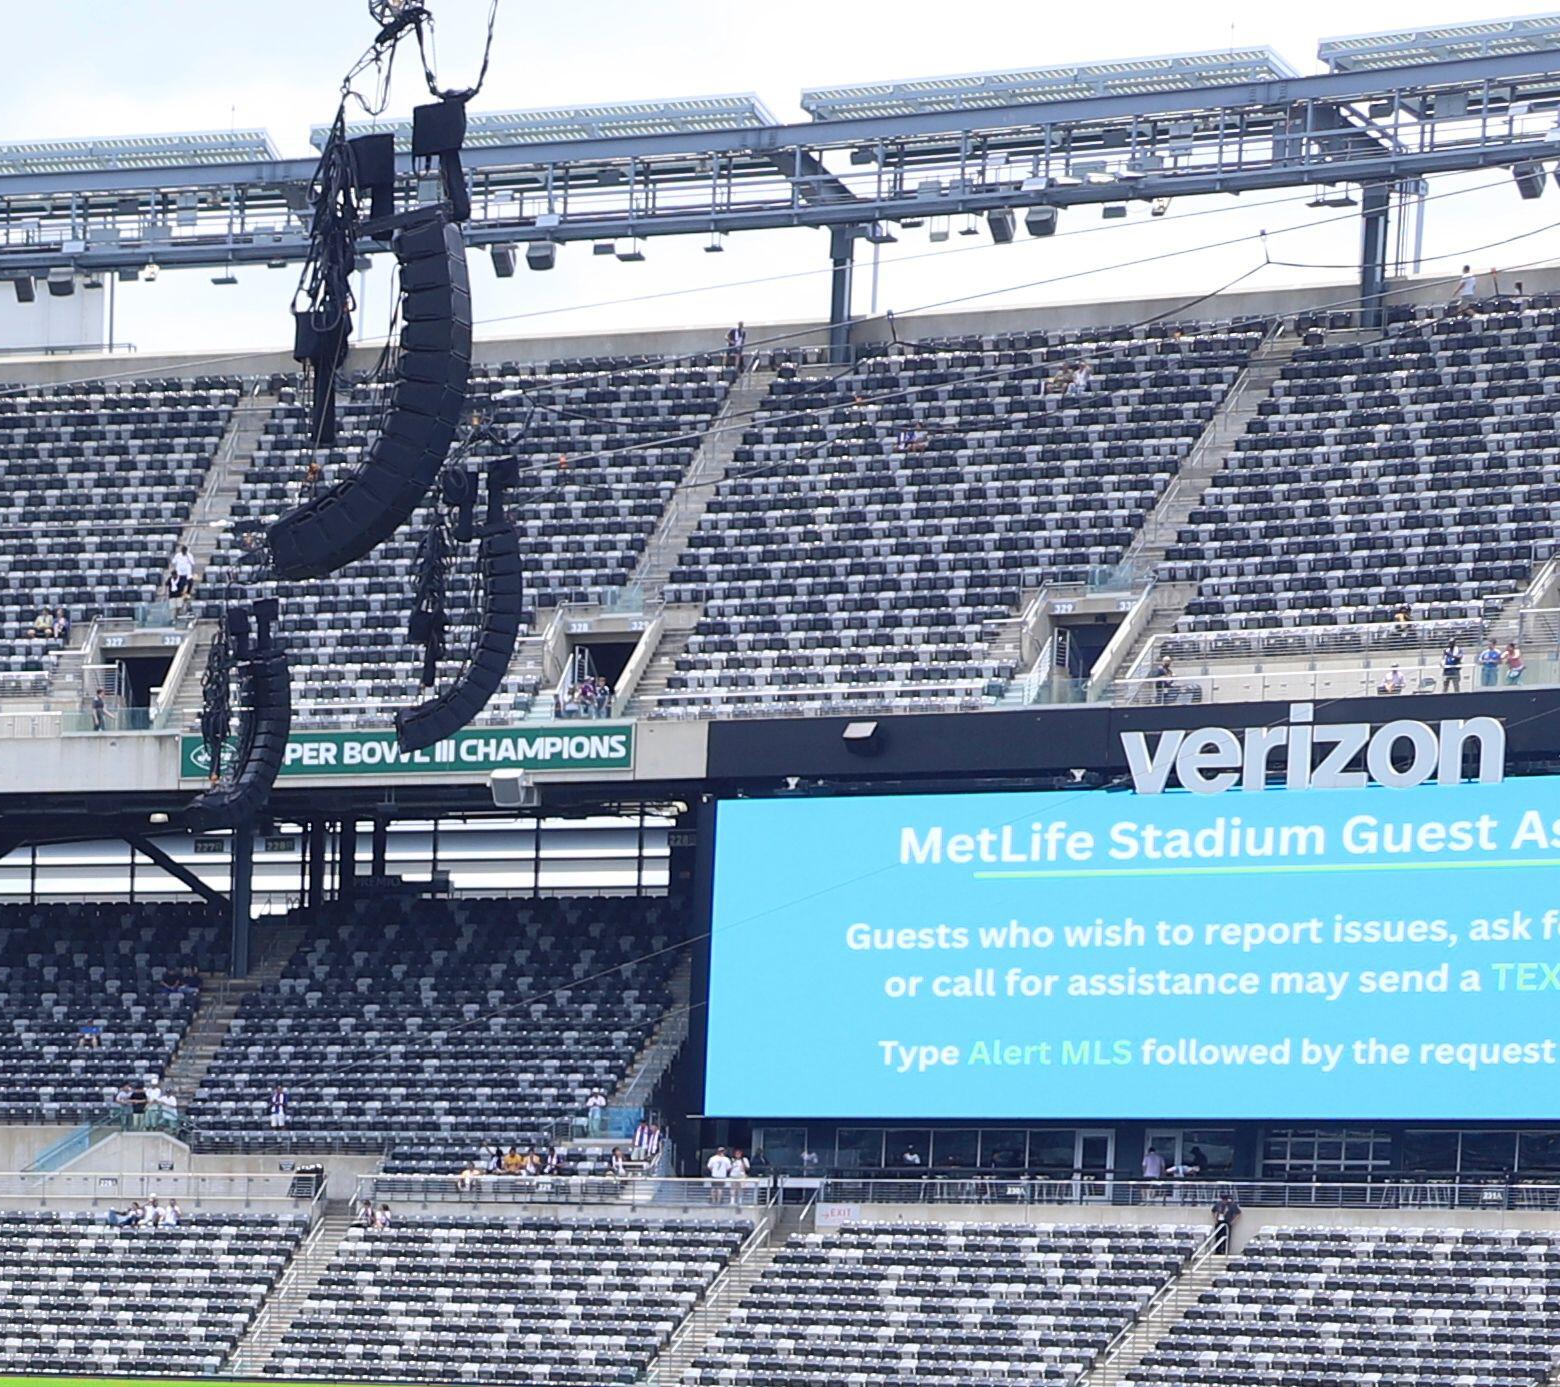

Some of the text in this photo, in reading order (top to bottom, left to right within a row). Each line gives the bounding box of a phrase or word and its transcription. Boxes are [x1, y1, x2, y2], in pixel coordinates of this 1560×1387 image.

[286, 739, 338, 767] PER
[342, 736, 430, 765] BOWL
[435, 736, 456, 762] III
[460, 732, 626, 764] CHAMPIONS
[1121, 700, 1506, 795] verizon
[899, 813, 1499, 865] MetLife Stadium Guest
[845, 910, 1533, 953] Guests who wish to report issues, ask
[883, 974, 926, 999] or
[930, 966, 998, 999] call
[1003, 966, 1062, 998] for
[1066, 965, 1263, 997] assistance
[1267, 970, 1352, 1002] may
[1357, 961, 1453, 995] send
[1458, 968, 1484, 993] a
[877, 1036, 1557, 1073] Type Alert MLS followed by the request
[830, 1207, 853, 1218] EXIT
